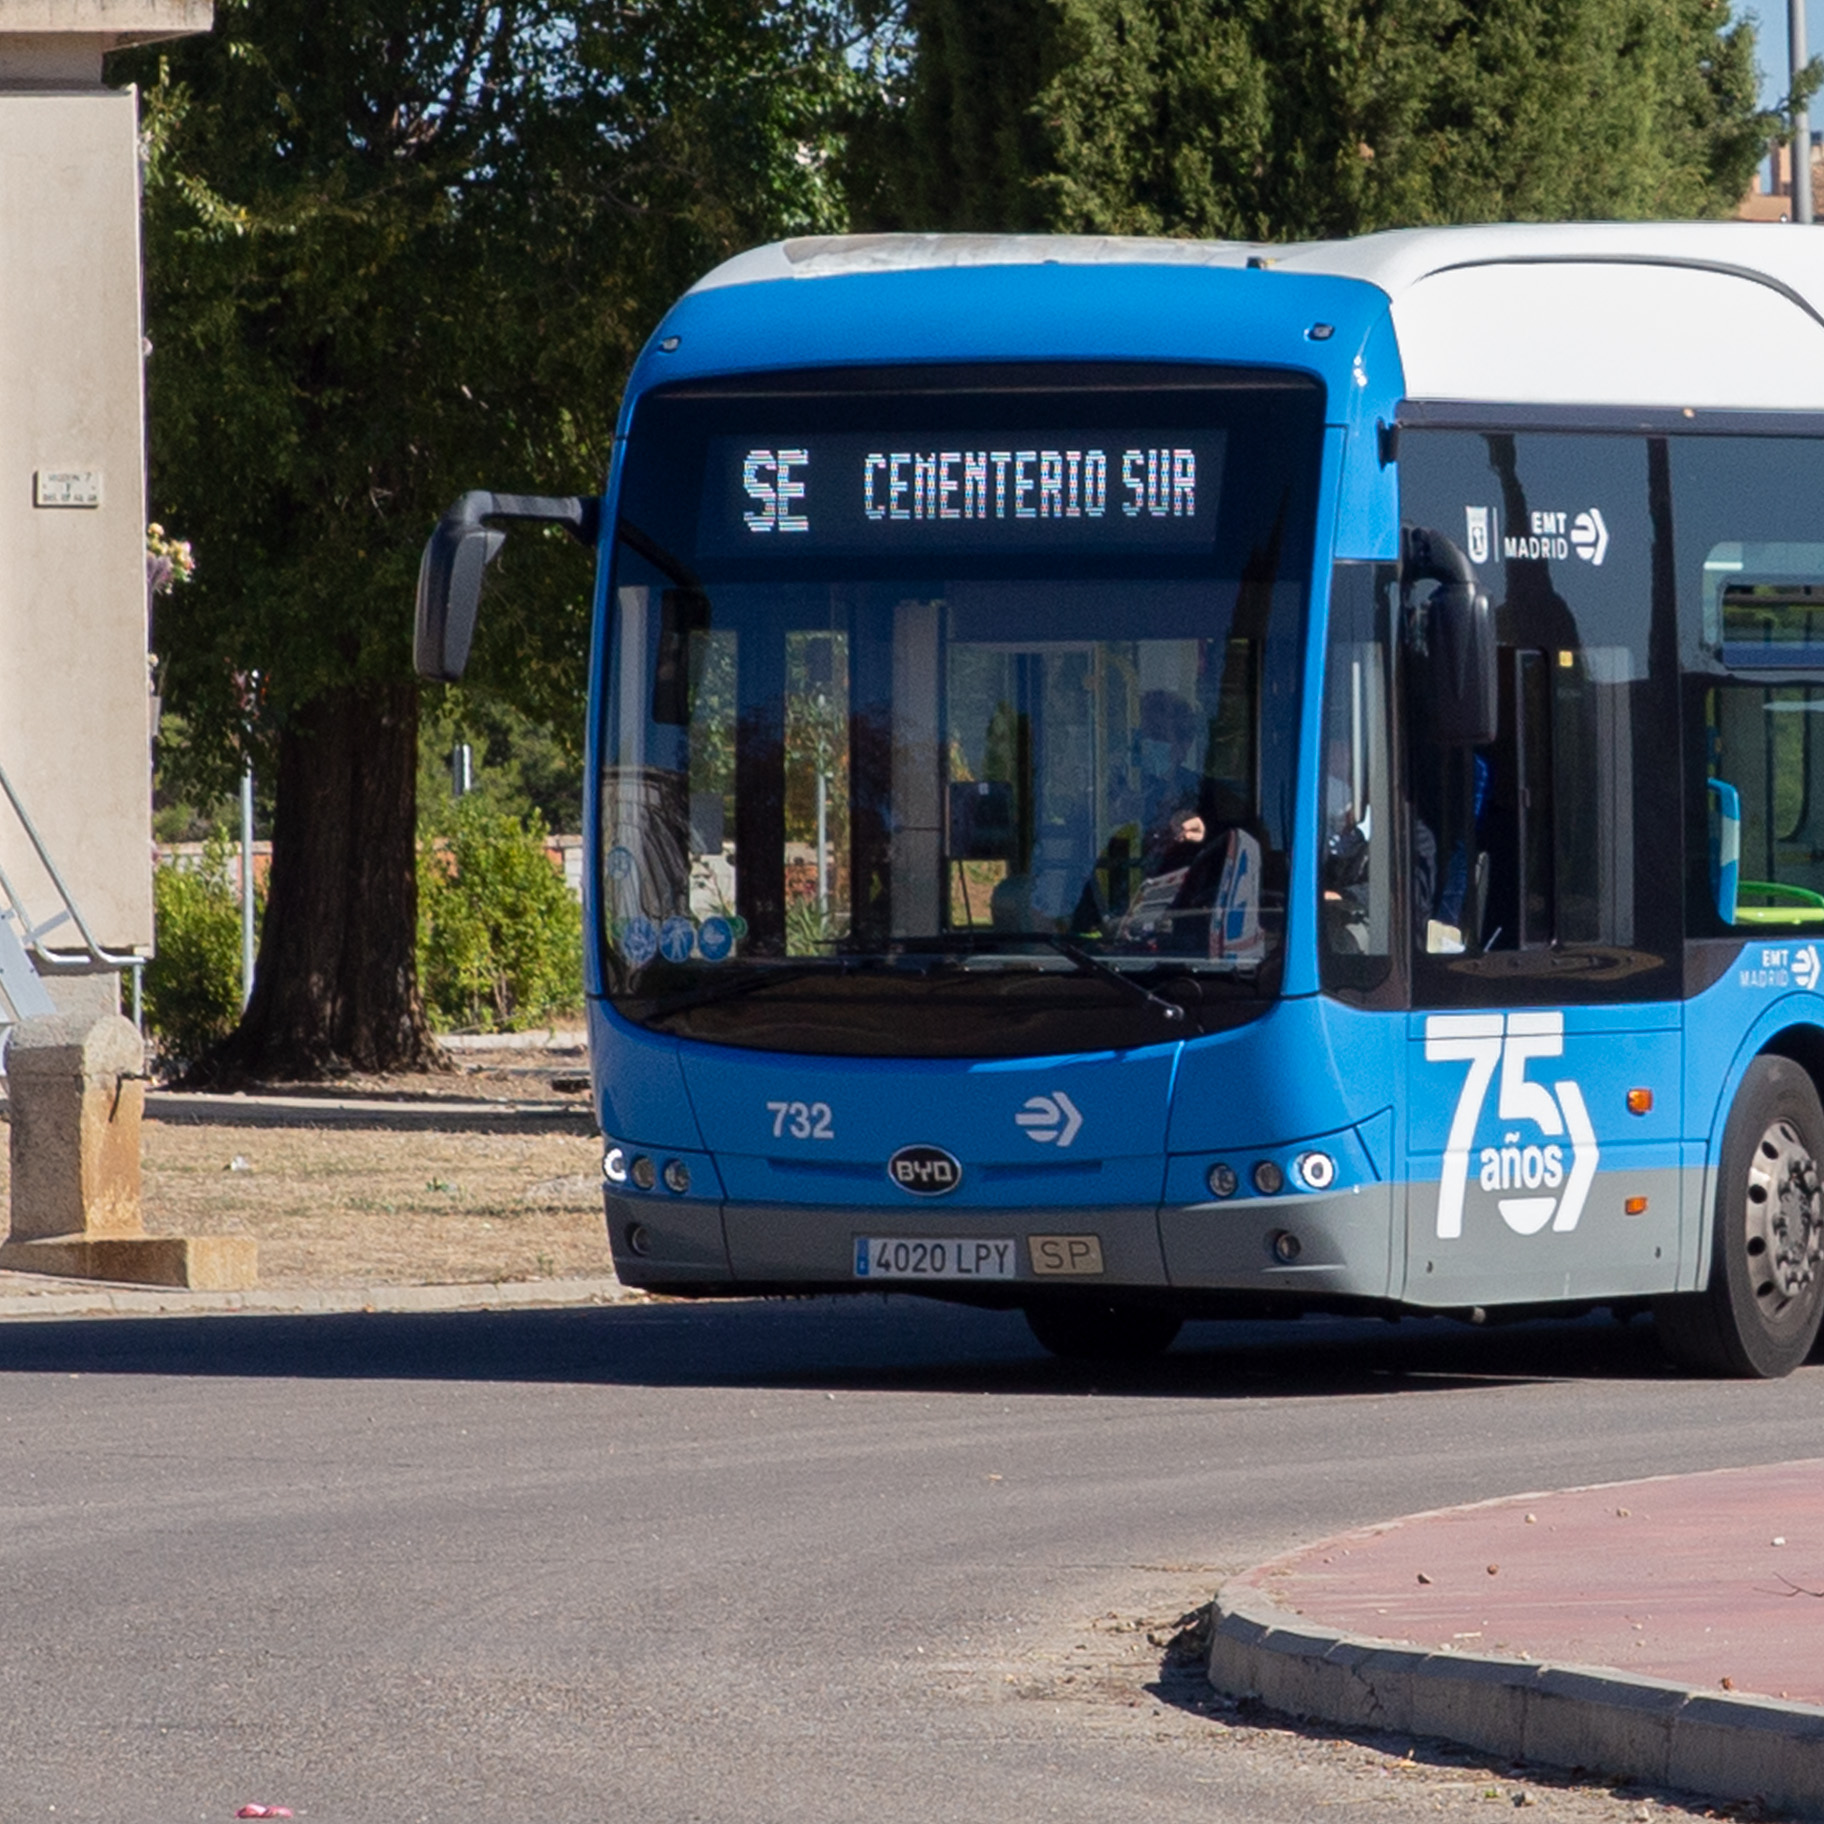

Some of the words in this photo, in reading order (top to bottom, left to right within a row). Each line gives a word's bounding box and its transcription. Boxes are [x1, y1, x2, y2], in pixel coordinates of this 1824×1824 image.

[743, 449, 809, 532] SE
[863, 450, 1107, 520] CEMENTERIO
[1122, 448, 1196, 517] SUR
[1530, 510, 1568, 535] EMT
[1503, 536, 1569, 561] MADRID
[1762, 949, 1790, 968] EMT
[1739, 969, 1790, 988] MADRID
[766, 1101, 835, 1140] 732
[1425, 1011, 1565, 1239] 75
[895, 1160, 953, 1182] BYD
[1479, 1131, 1564, 1192] años
[876, 1242, 947, 1274] 4020
[956, 1242, 1010, 1274] LPY
[1039, 1242, 1091, 1270] SP
